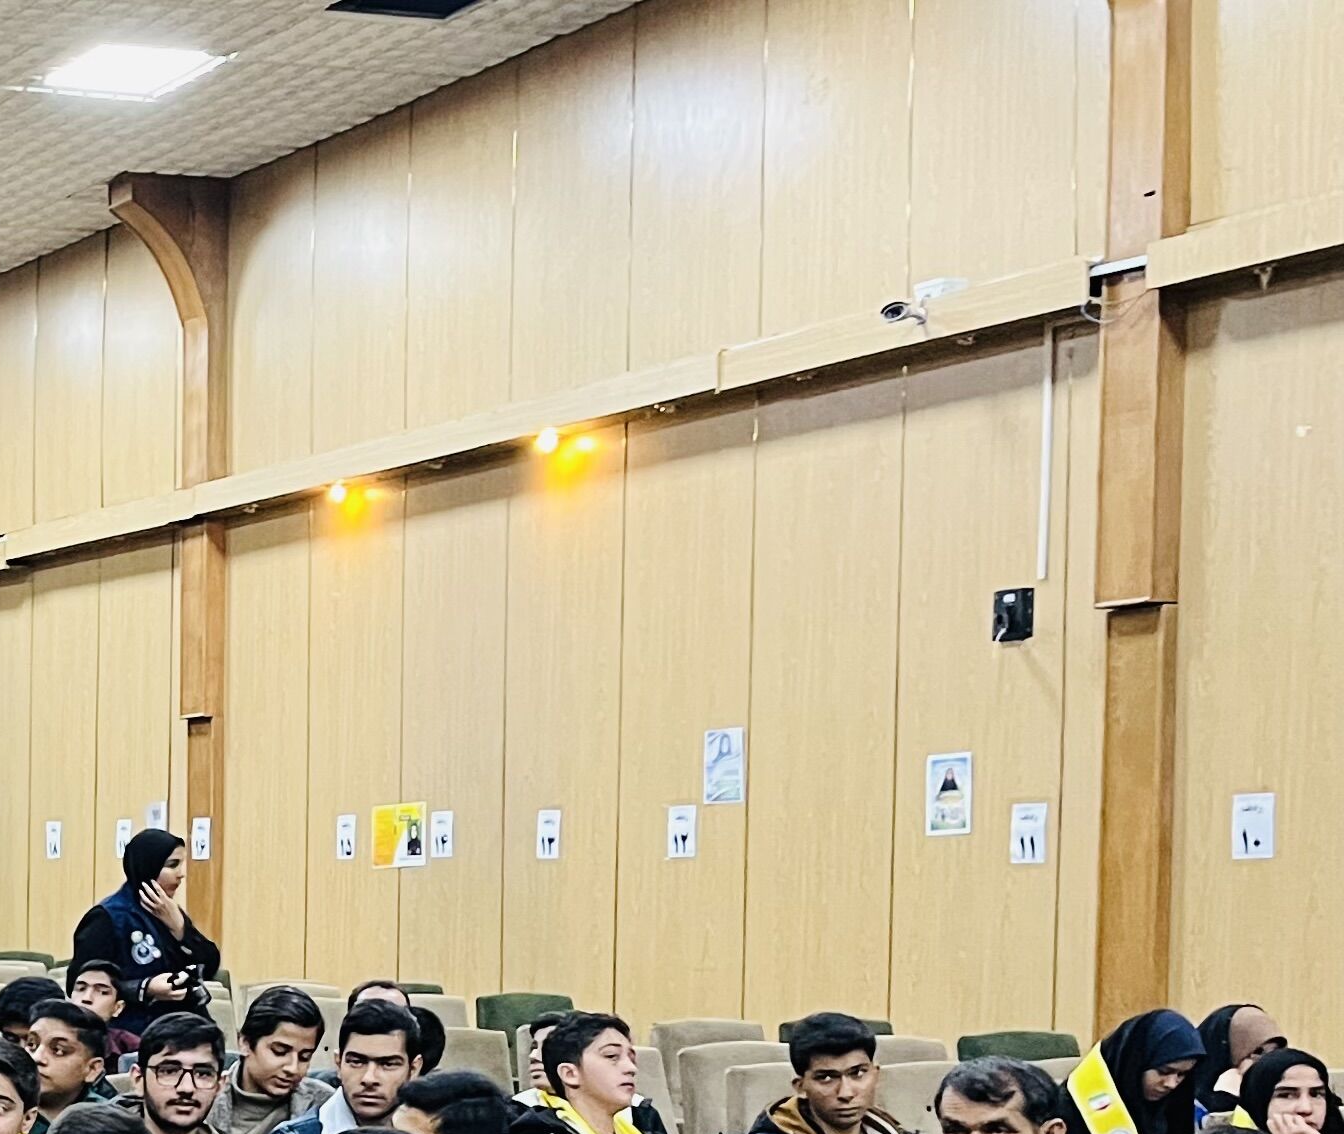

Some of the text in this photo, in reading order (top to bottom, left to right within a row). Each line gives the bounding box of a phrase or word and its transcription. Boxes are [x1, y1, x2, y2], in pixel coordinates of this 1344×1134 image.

[340, 838, 352, 856] ۱۵
[673, 832, 689, 854] ۱۲
[1020, 835, 1036, 859] ۱۱
[1242, 828, 1261, 855] ۱۰
